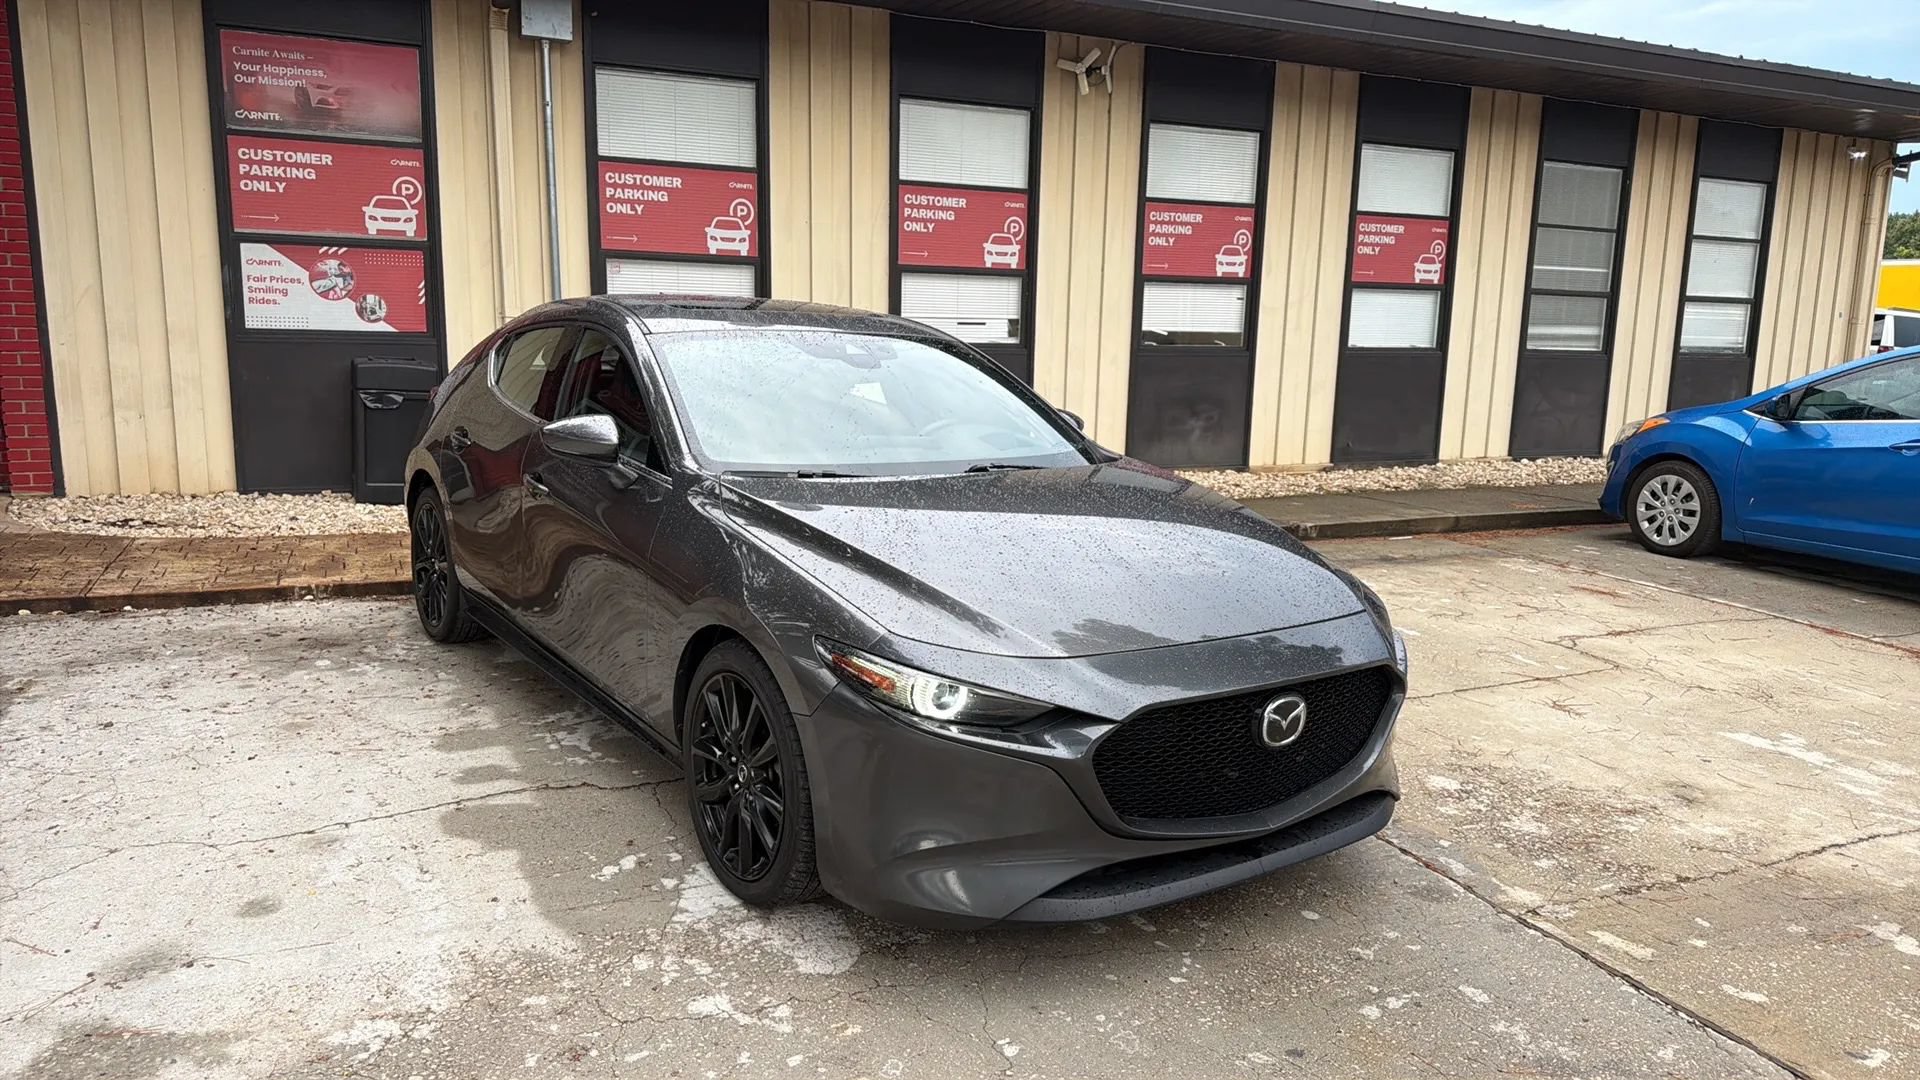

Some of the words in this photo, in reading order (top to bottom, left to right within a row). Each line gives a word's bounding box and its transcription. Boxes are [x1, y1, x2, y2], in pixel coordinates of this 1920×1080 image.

[232, 46, 270, 57] Carnite
[272, 49, 305, 60] Awaits
[233, 61, 261, 72] Your
[263, 64, 327, 79] Happiness,
[234, 74, 256, 84] Our
[258, 75, 306, 88] Mission!
[237, 147, 333, 166] CUSTOMER
[239, 163, 317, 180] PARKING
[239, 179, 287, 193] ONLY
[605, 172, 683, 188] CUSTOMER
[606, 187, 669, 202] PARKING
[904, 194, 967, 208] CUSTOMER
[606, 202, 645, 215] ONLY
[904, 208, 955, 221] PARKING
[1149, 211, 1203, 223] CUSTOMER
[903, 221, 936, 233] ONLY
[1149, 223, 1193, 235] PARKING
[1359, 223, 1405, 234] CUSTOMER
[1148, 236, 1176, 246] ONLY
[1358, 234, 1395, 244] PARKING
[1357, 245, 1381, 255] ONLY
[247, 274, 268, 283] Fair
[269, 275, 305, 286] Prices,
[247, 286, 289, 297] Smiling
[248, 296, 281, 305] Rides.
